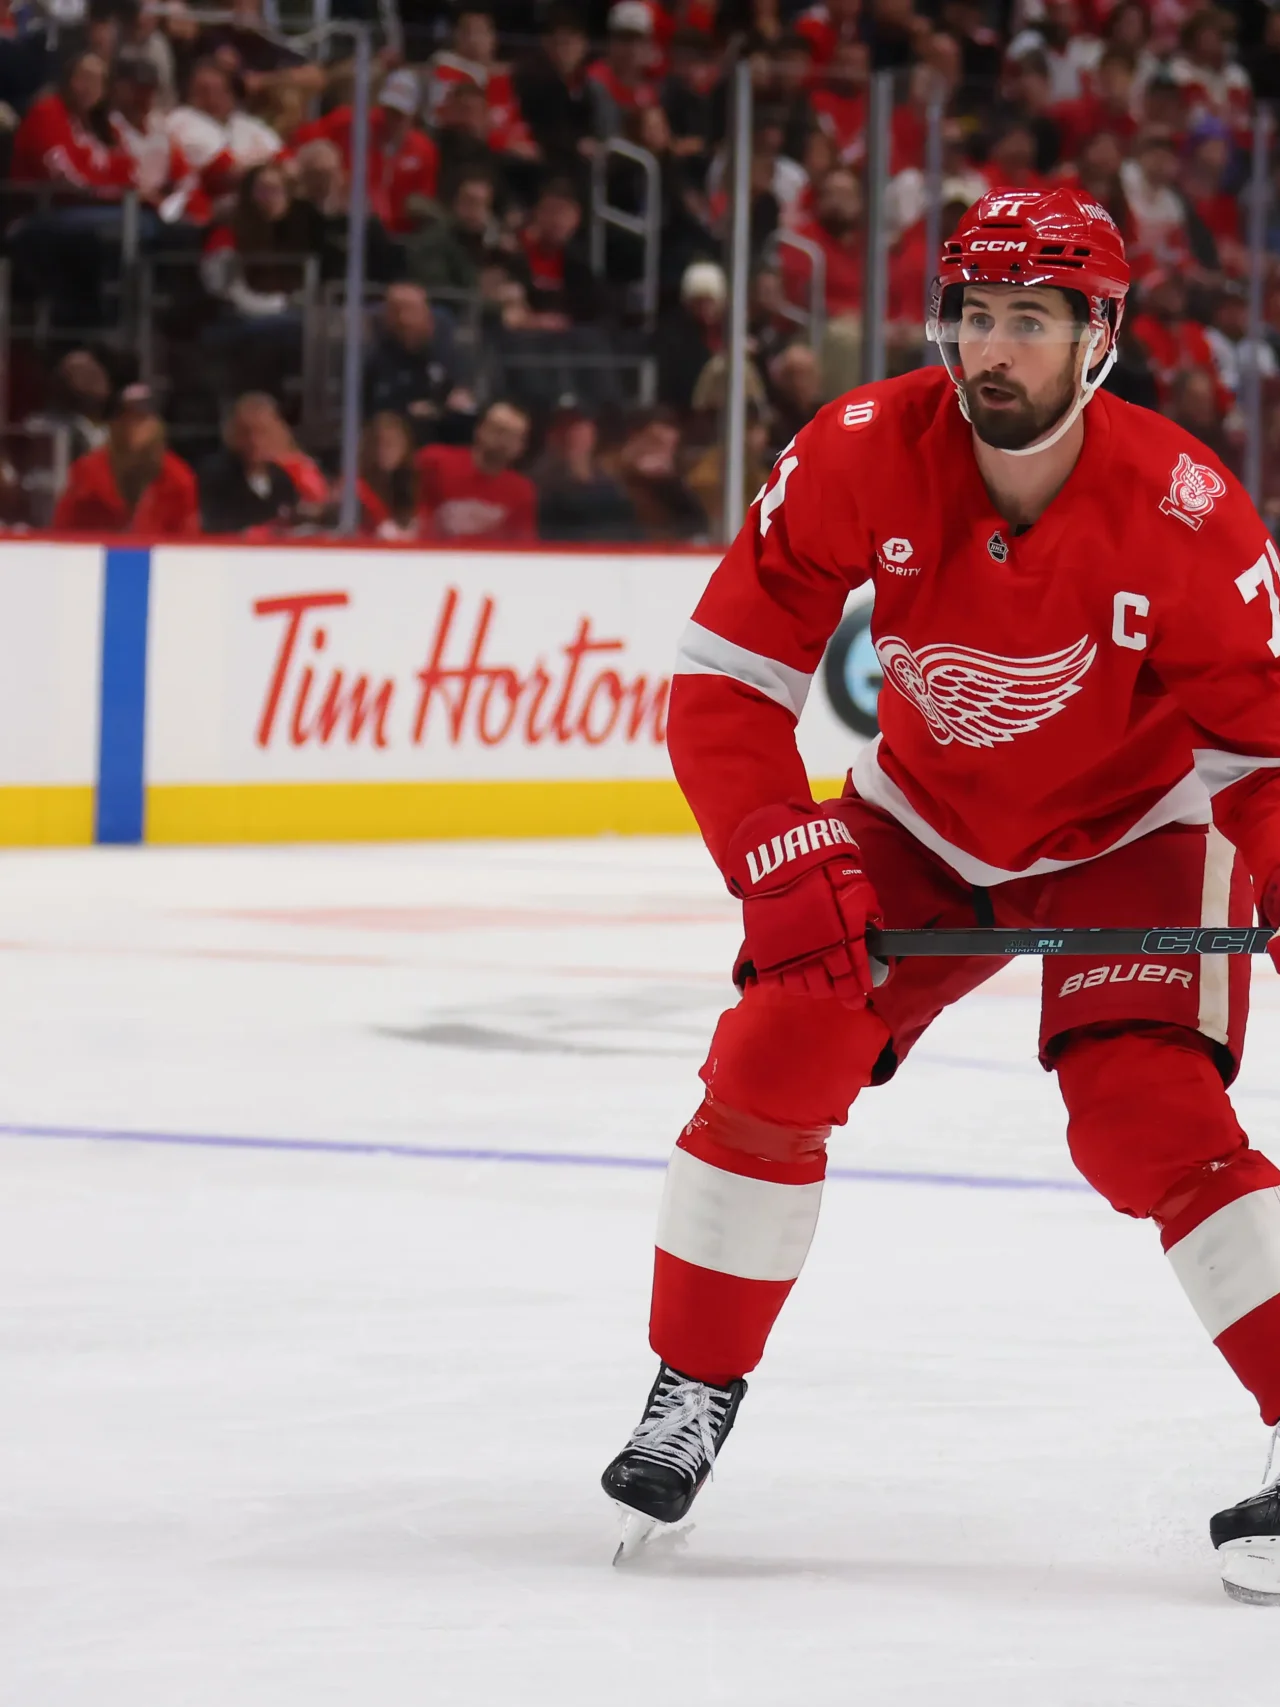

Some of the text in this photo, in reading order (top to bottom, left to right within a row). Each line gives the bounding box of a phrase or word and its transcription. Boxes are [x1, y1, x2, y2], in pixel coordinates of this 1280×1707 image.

[969, 240, 1028, 253] CCM
[1111, 590, 1150, 651] C
[252, 592, 395, 750] Tim
